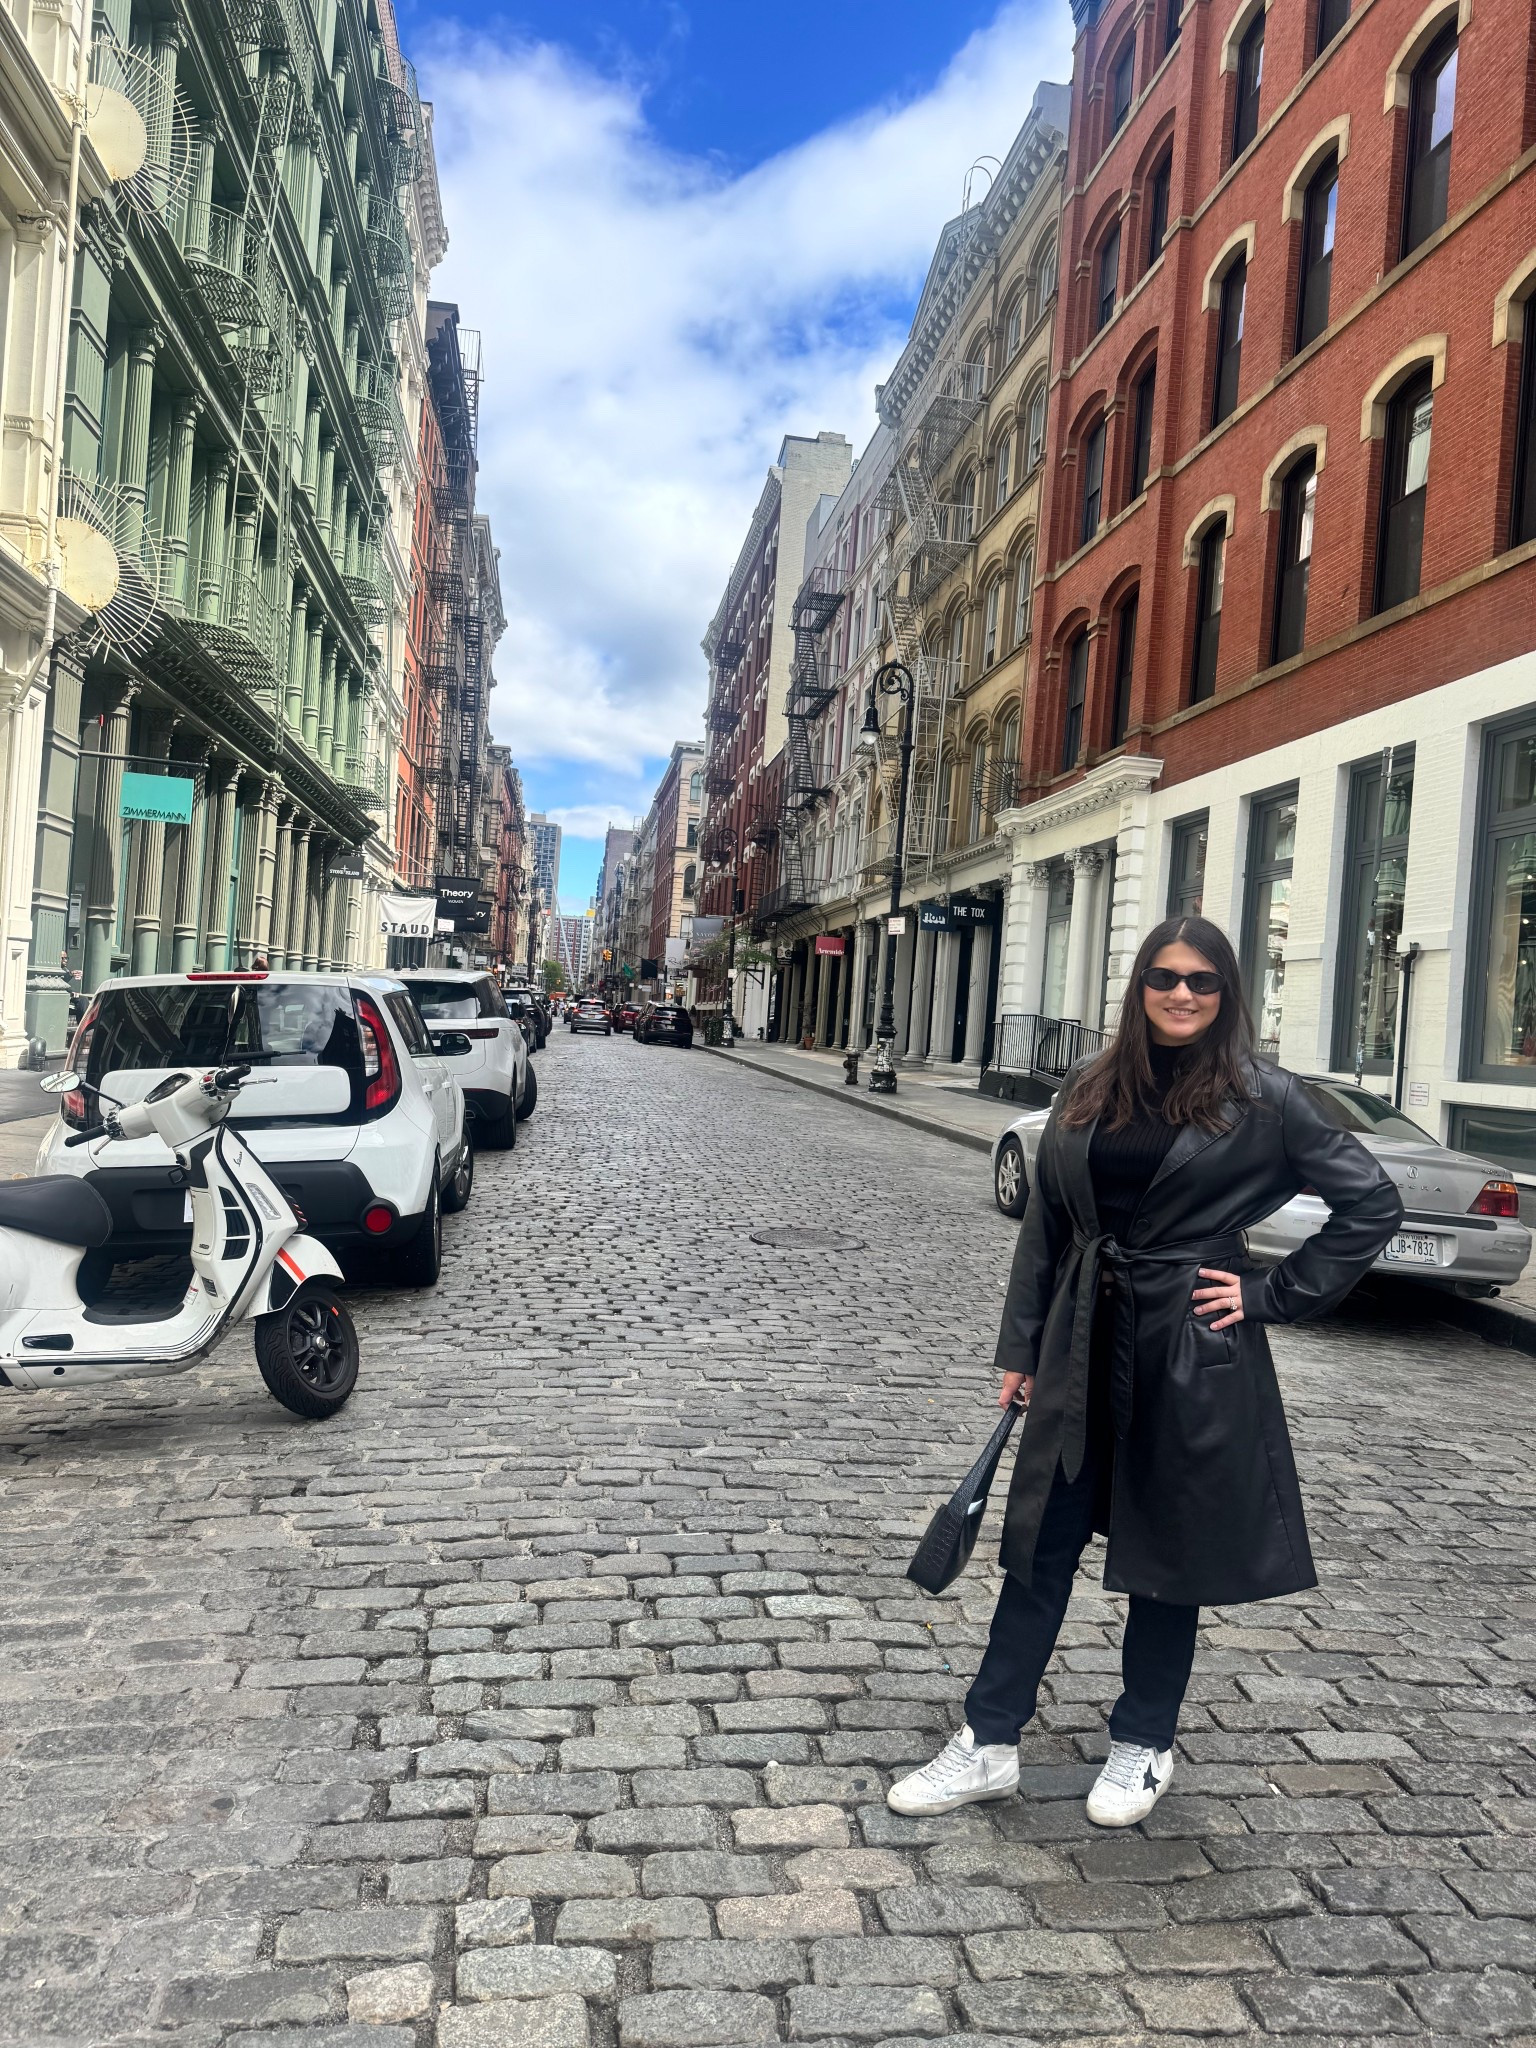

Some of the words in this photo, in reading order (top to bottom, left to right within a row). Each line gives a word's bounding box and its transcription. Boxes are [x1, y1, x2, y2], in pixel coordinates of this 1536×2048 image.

[122, 806, 187, 822] ZIMMERMANN
[440, 888, 474, 898] Theory
[953, 906, 968, 917] THE
[971, 907, 986, 918] TOX
[381, 921, 430, 935] STAUD
[1396, 1182, 1442, 1193] CURA
[1412, 1240, 1434, 1257] 7832
